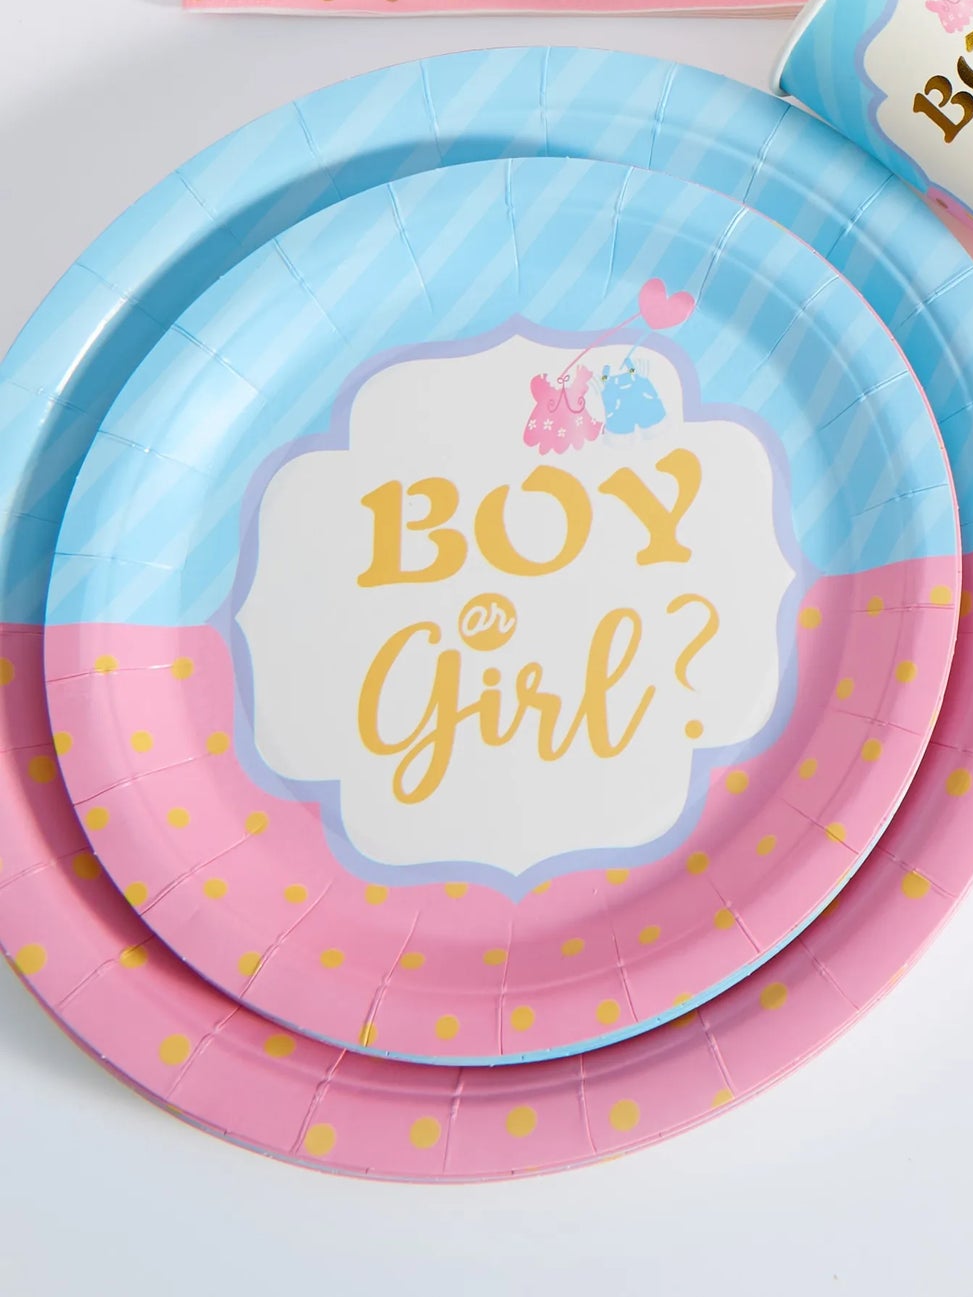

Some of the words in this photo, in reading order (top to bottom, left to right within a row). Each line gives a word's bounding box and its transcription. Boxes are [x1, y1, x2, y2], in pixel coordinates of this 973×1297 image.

[356, 448, 702, 588] BOY
[462, 602, 516, 637] or
[357, 593, 720, 805] Girl?
